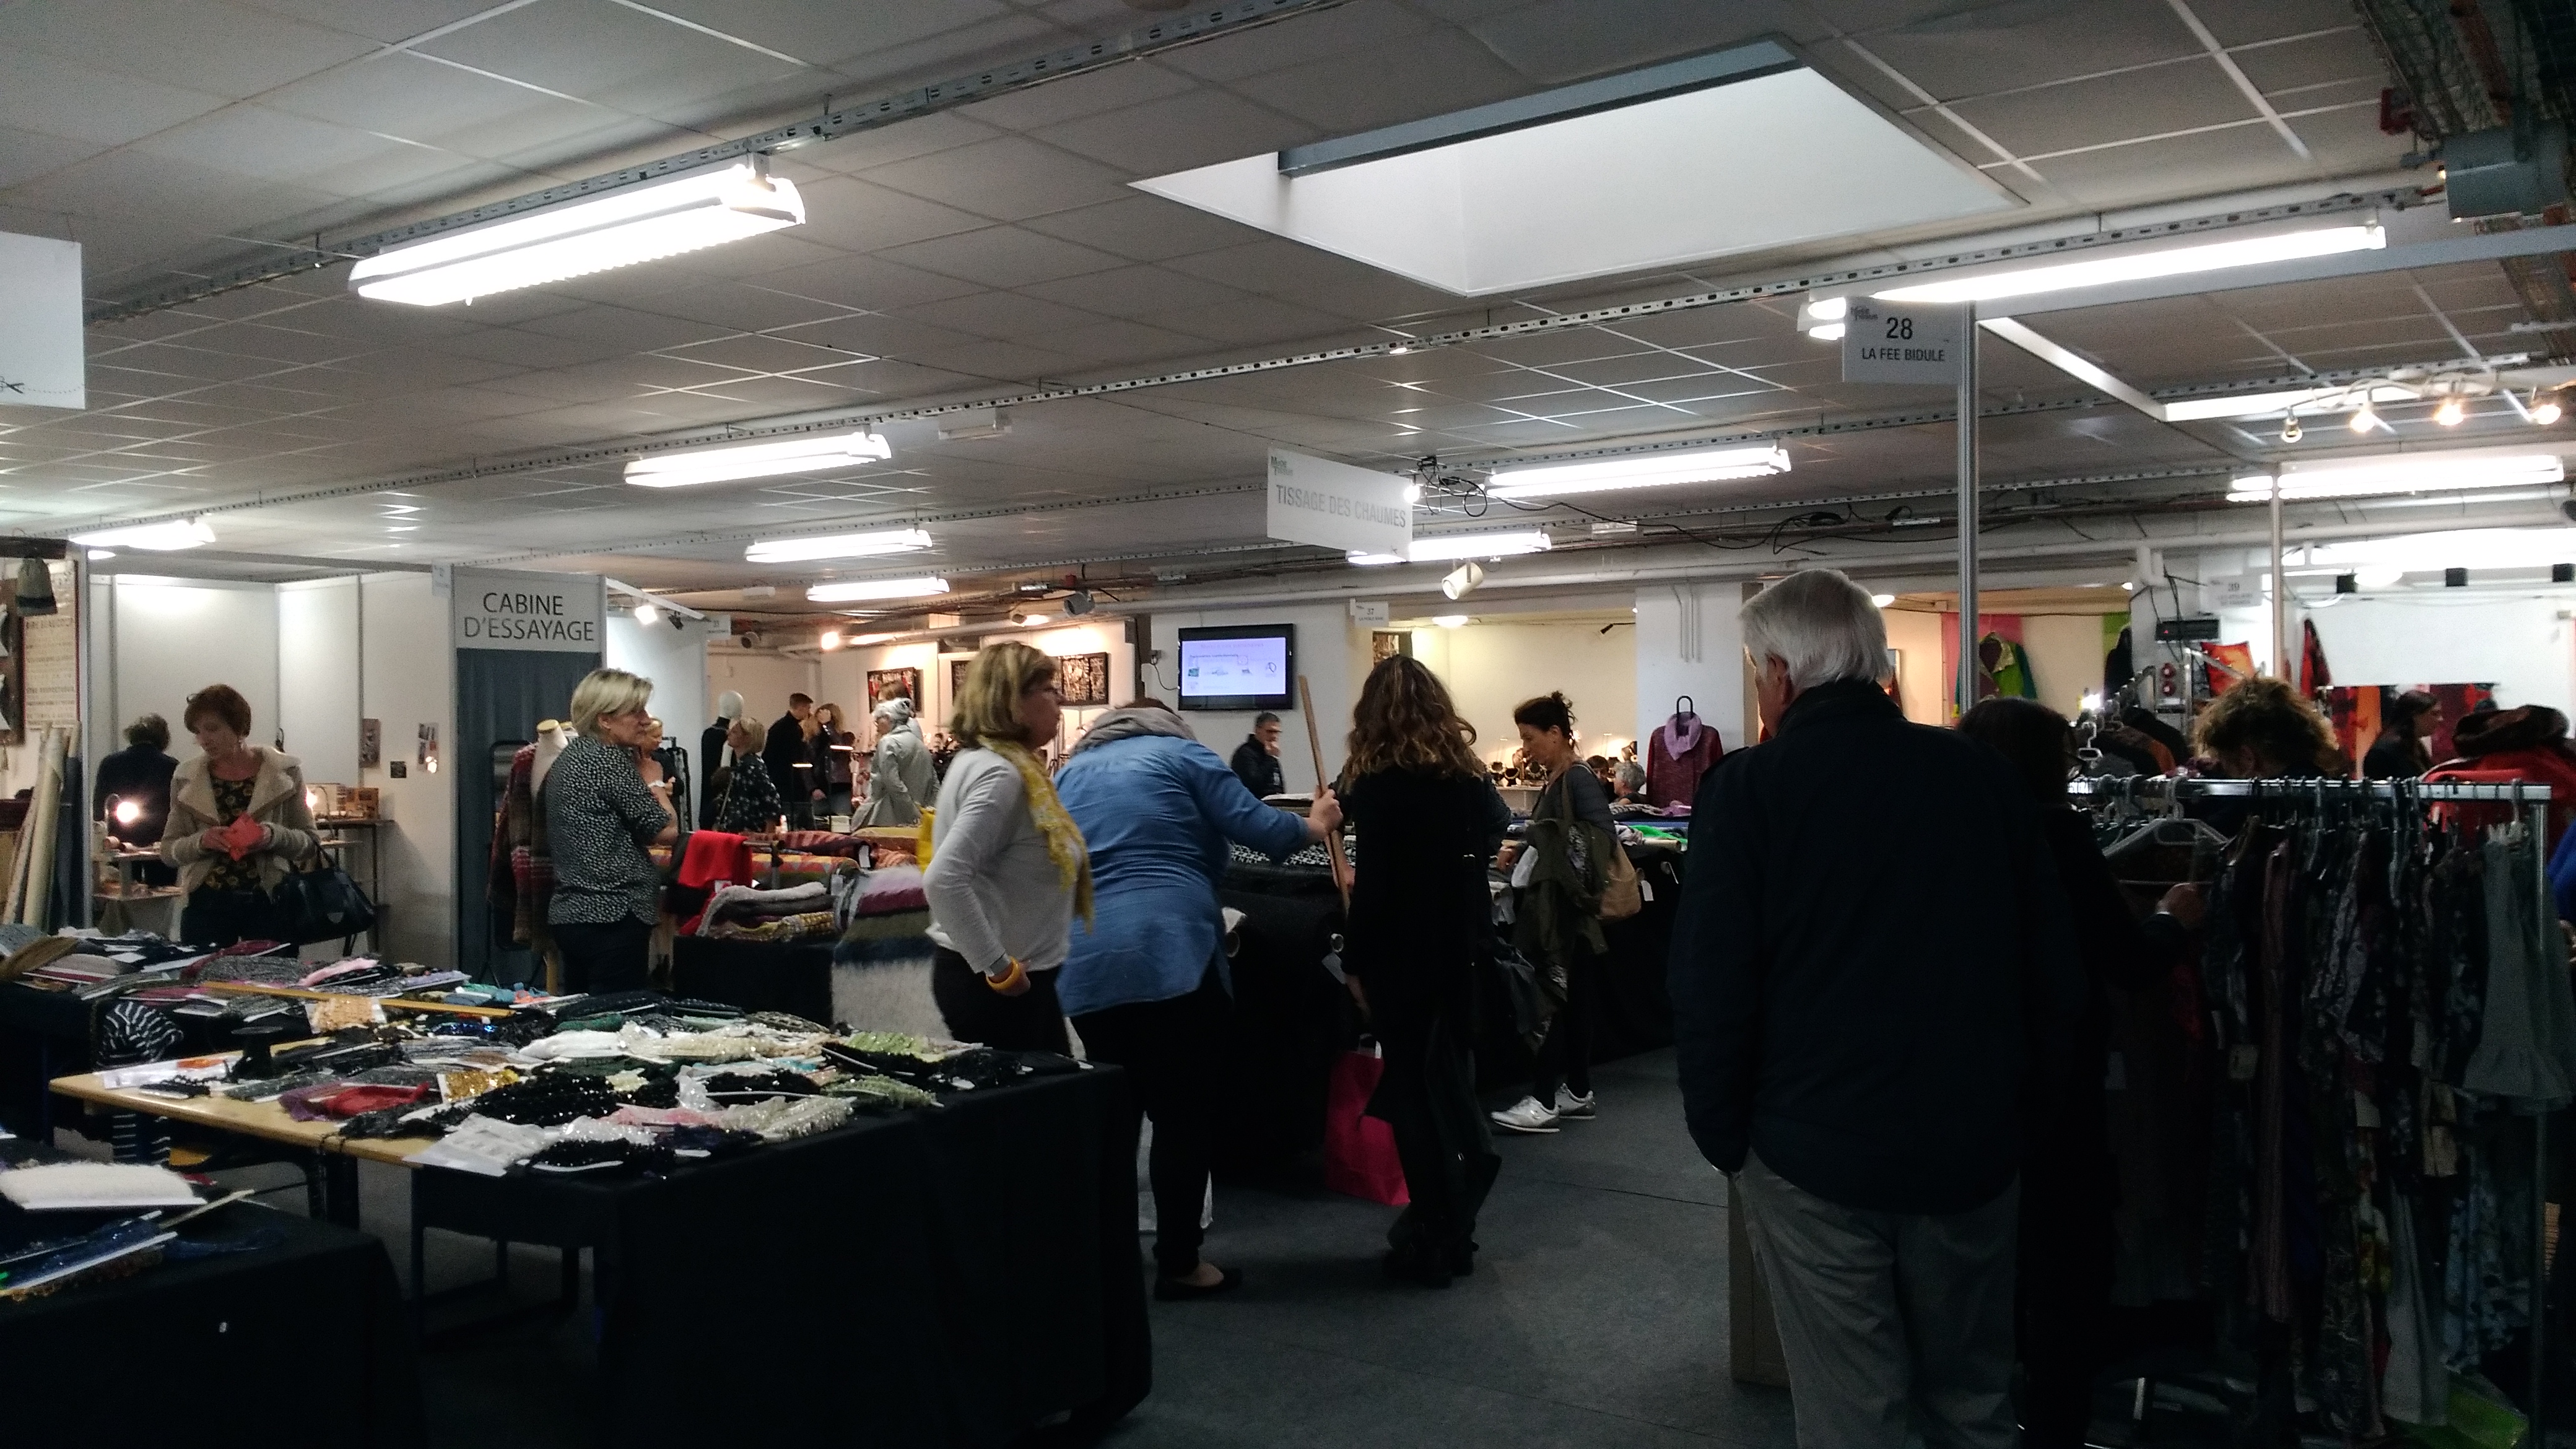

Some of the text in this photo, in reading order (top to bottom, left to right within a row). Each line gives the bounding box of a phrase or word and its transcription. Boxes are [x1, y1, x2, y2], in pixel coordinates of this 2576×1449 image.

[1886, 317, 1913, 339] 28
[1862, 347, 1945, 362] LA FEE BIDULE
[1276, 484, 1406, 528] TISSAGE DES CHAUMES
[483, 592, 564, 616] CABINE
[464, 617, 594, 642] D'ESSAYAGE
